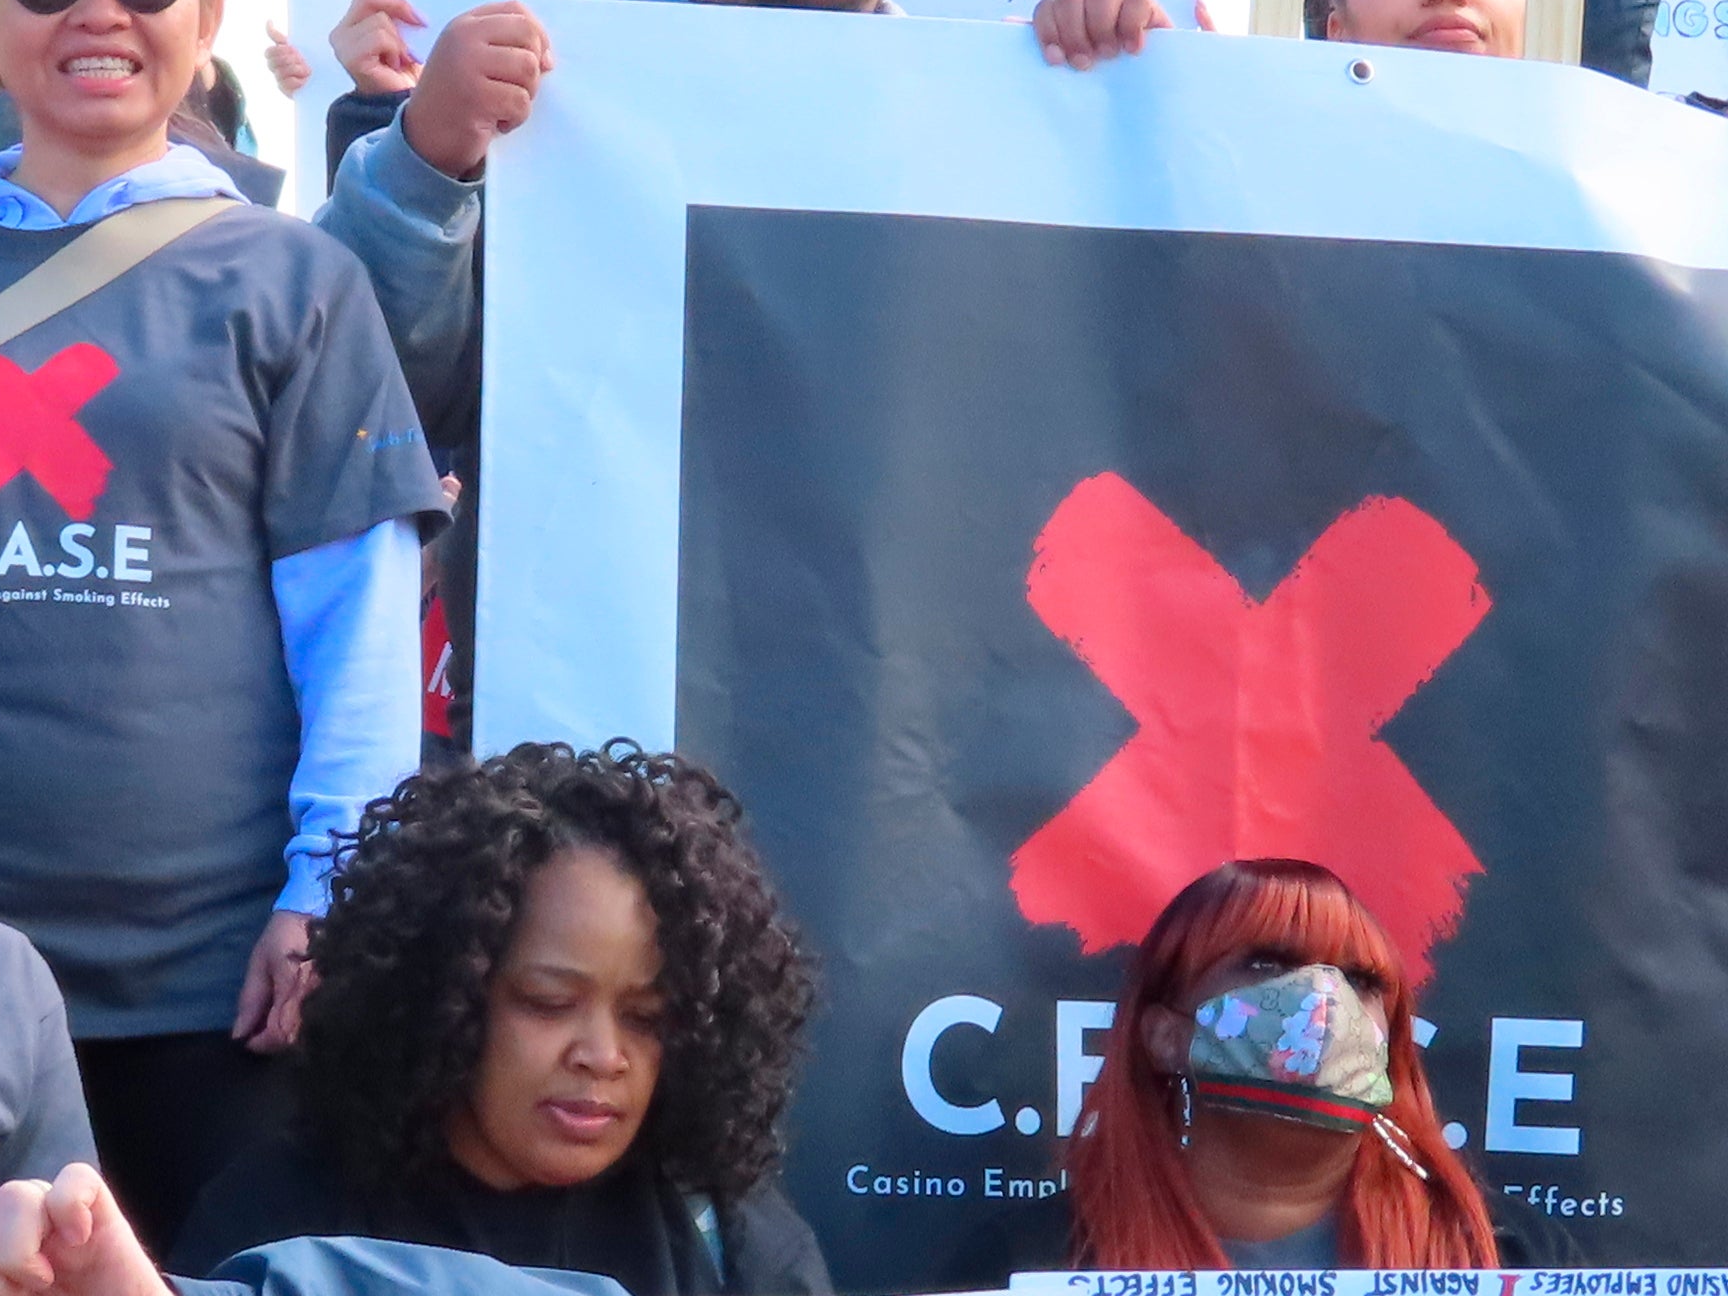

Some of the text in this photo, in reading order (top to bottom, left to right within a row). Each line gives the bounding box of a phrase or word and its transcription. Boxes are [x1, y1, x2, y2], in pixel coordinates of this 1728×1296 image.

[53, 588, 115, 607] Smoking
[121, 591, 170, 609] Effects
[846, 1164, 965, 1196] Casino
[1503, 1184, 1624, 1217] ffects
[1529, 1272, 1658, 1296] EMPLOYEES
